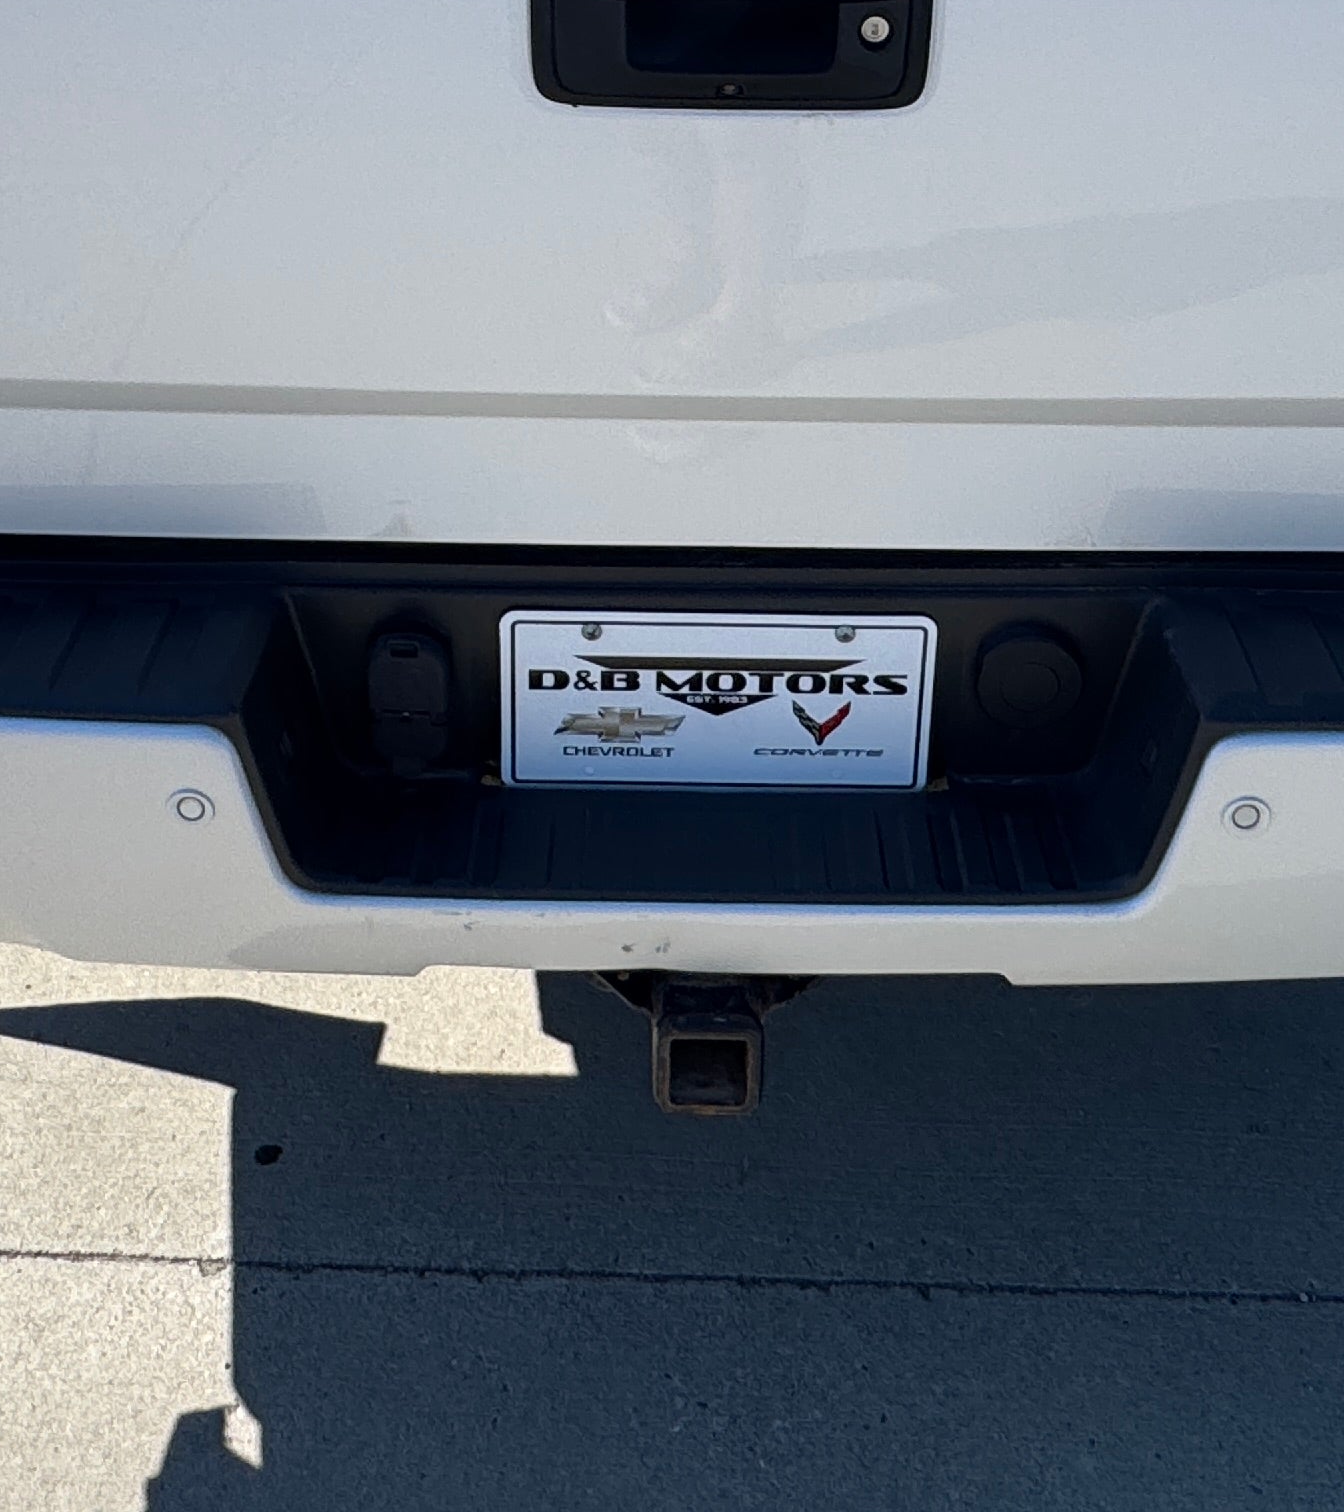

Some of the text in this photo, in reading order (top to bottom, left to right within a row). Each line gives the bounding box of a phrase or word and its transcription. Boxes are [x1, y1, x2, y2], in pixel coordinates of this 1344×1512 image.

[528, 668, 908, 696] D&B MOTORS
[562, 745, 675, 759] CHEVROLET
[753, 747, 884, 758] CORVETTE
